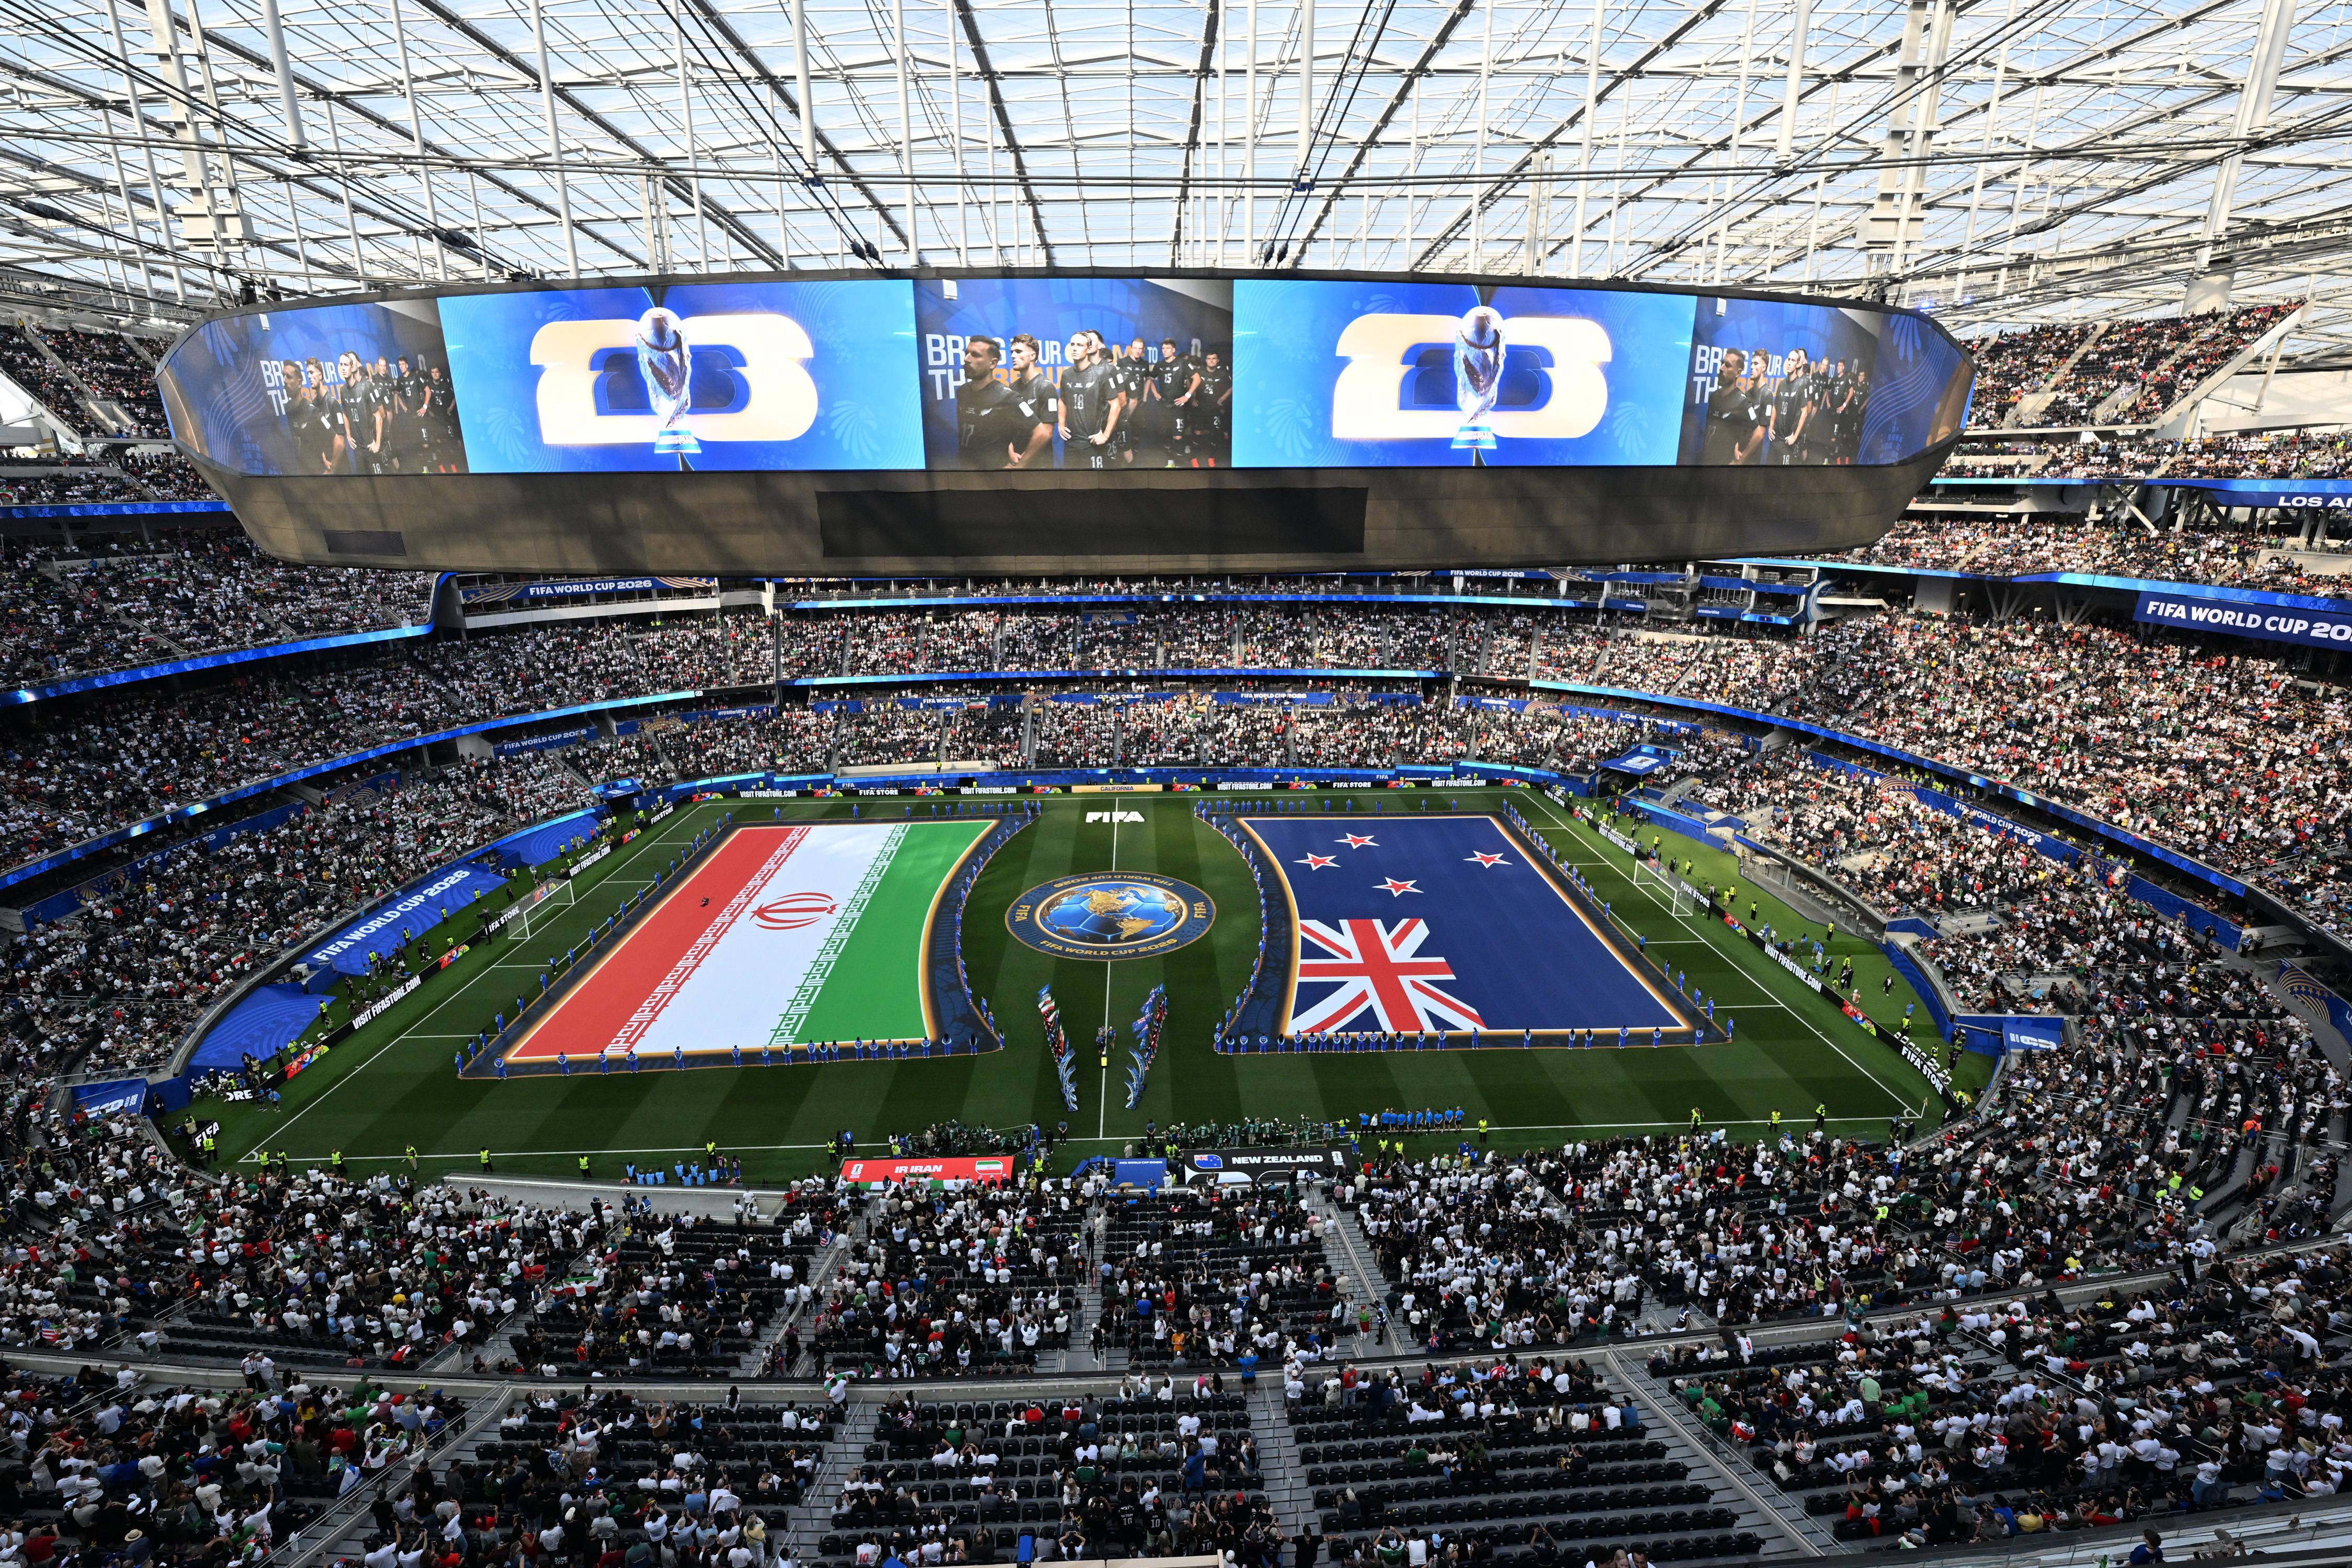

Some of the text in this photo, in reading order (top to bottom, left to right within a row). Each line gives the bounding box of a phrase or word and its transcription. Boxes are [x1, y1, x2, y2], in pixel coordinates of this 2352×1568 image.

[926, 334, 1007, 365] BRG
[1147, 347, 1158, 363] TO
[1695, 345, 1748, 374] BRG
[260, 360, 306, 387] BRG
[1164, 373, 1172, 384] 15
[406, 387, 411, 397] 15
[928, 369, 972, 400] TH
[1693, 377, 1722, 404] TH
[267, 390, 291, 417] TH
[1073, 394, 1084, 410] 18
[351, 408, 360, 422] 18
[1091, 456, 1103, 468] 18
[2278, 496, 2323, 507] LOS
[529, 580, 652, 595] FIFA WORLD CUP 2026
[2146, 601, 2352, 642] FIFA WORLD CUP 20
[504, 741, 521, 750] FIFA
[522, 736, 547, 746] WORLD
[1553, 796, 1565, 808] STORE
[660, 805, 674, 820] STORE
[1086, 811, 1145, 823] FIFA
[1972, 808, 2042, 843] WORLD CUP 2026
[1598, 826, 1635, 856] VISIT FIFASTORE.COM
[569, 845, 611, 877] VISIT FIFASTORE.COM
[1053, 876, 1090, 888] 2026
[1156, 878, 1175, 887] FIFA
[1692, 888, 1710, 908] STORE
[312, 870, 470, 960] FIFA WORLD CUP 2026
[500, 905, 520, 924] STORE
[1015, 904, 1031, 923] FIFA
[1194, 902, 1206, 919] FIFA
[1040, 940, 1064, 952] FIFA
[1065, 947, 1110, 956] WORLD
[1137, 938, 1179, 953] 2026
[1765, 943, 1822, 993] VISIT FIFASTORE.COM
[352, 975, 421, 1030] VISIT FIFASTORE.COM
[1901, 1046, 1943, 1096] FIFA STORE
[194, 1121, 220, 1148] FIFA
[1232, 1156, 1262, 1165] NEW
[1262, 1155, 1323, 1163] ZEALAND
[1745, 1341, 1751, 1350] 9
[1333, 1384, 1340, 1392] 26
[1854, 1405, 1862, 1414] 10
[1151, 1519, 1160, 1528] 10
[859, 1554, 869, 1563] 10
